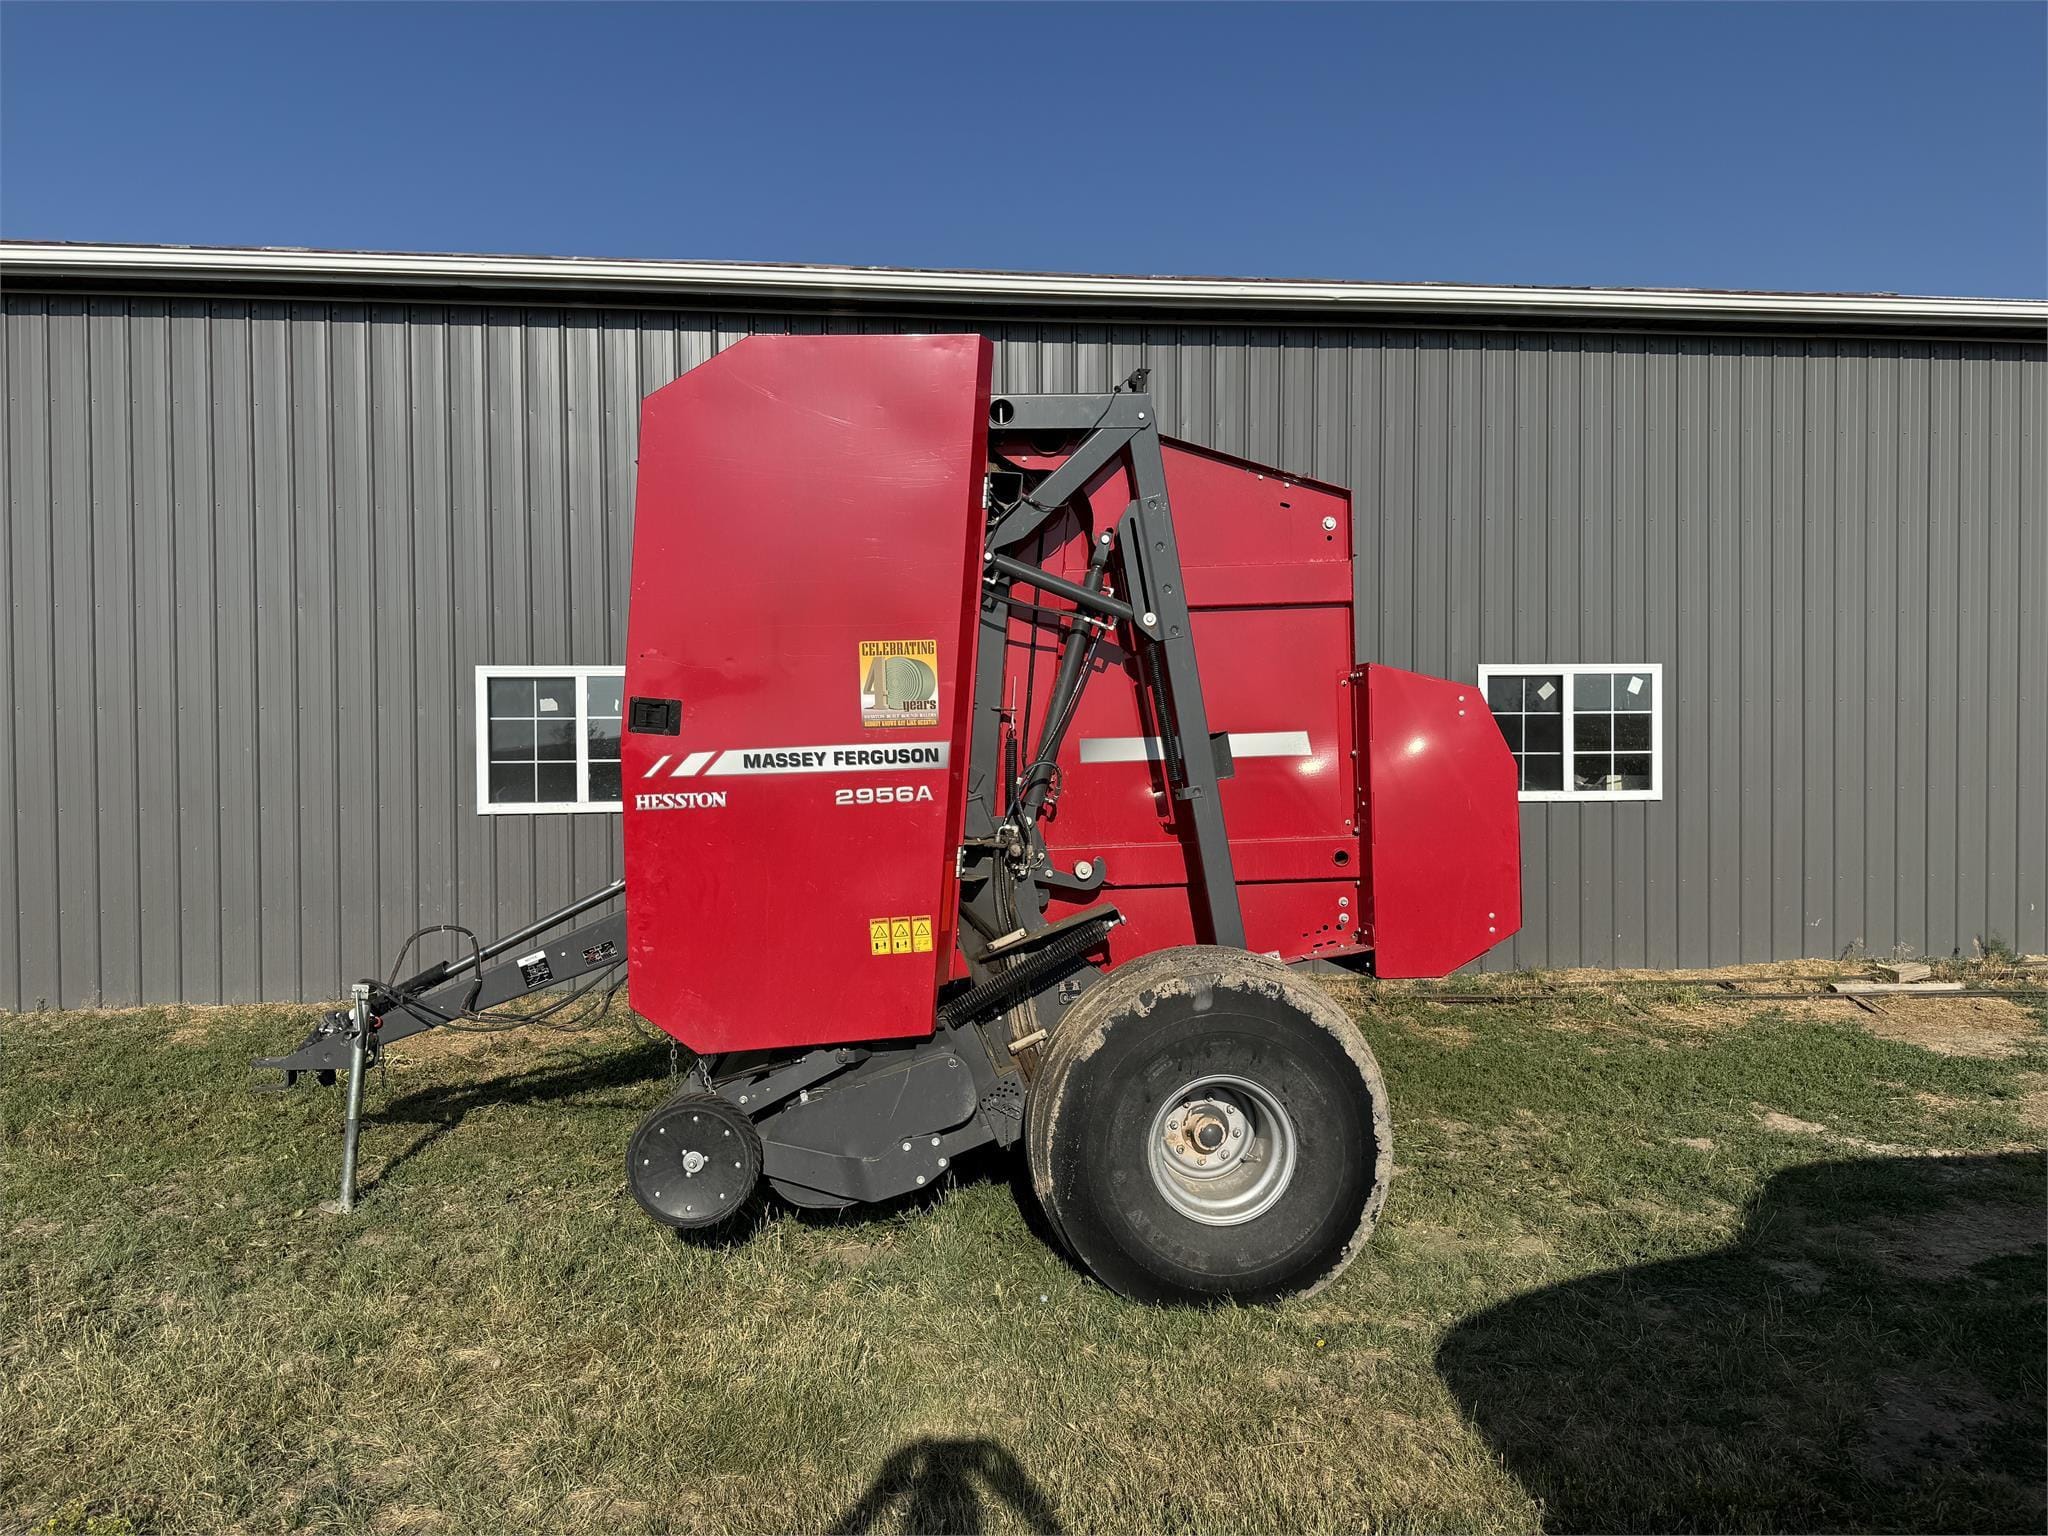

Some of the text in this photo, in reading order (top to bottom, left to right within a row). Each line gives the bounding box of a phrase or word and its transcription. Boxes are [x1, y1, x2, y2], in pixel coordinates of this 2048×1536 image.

[861, 641, 935, 656] CELEBRATING
[903, 699, 937, 712] years
[743, 747, 939, 769] MASSEY FERGUSON
[635, 791, 727, 811] HESSTON
[835, 785, 934, 805] 2956A
